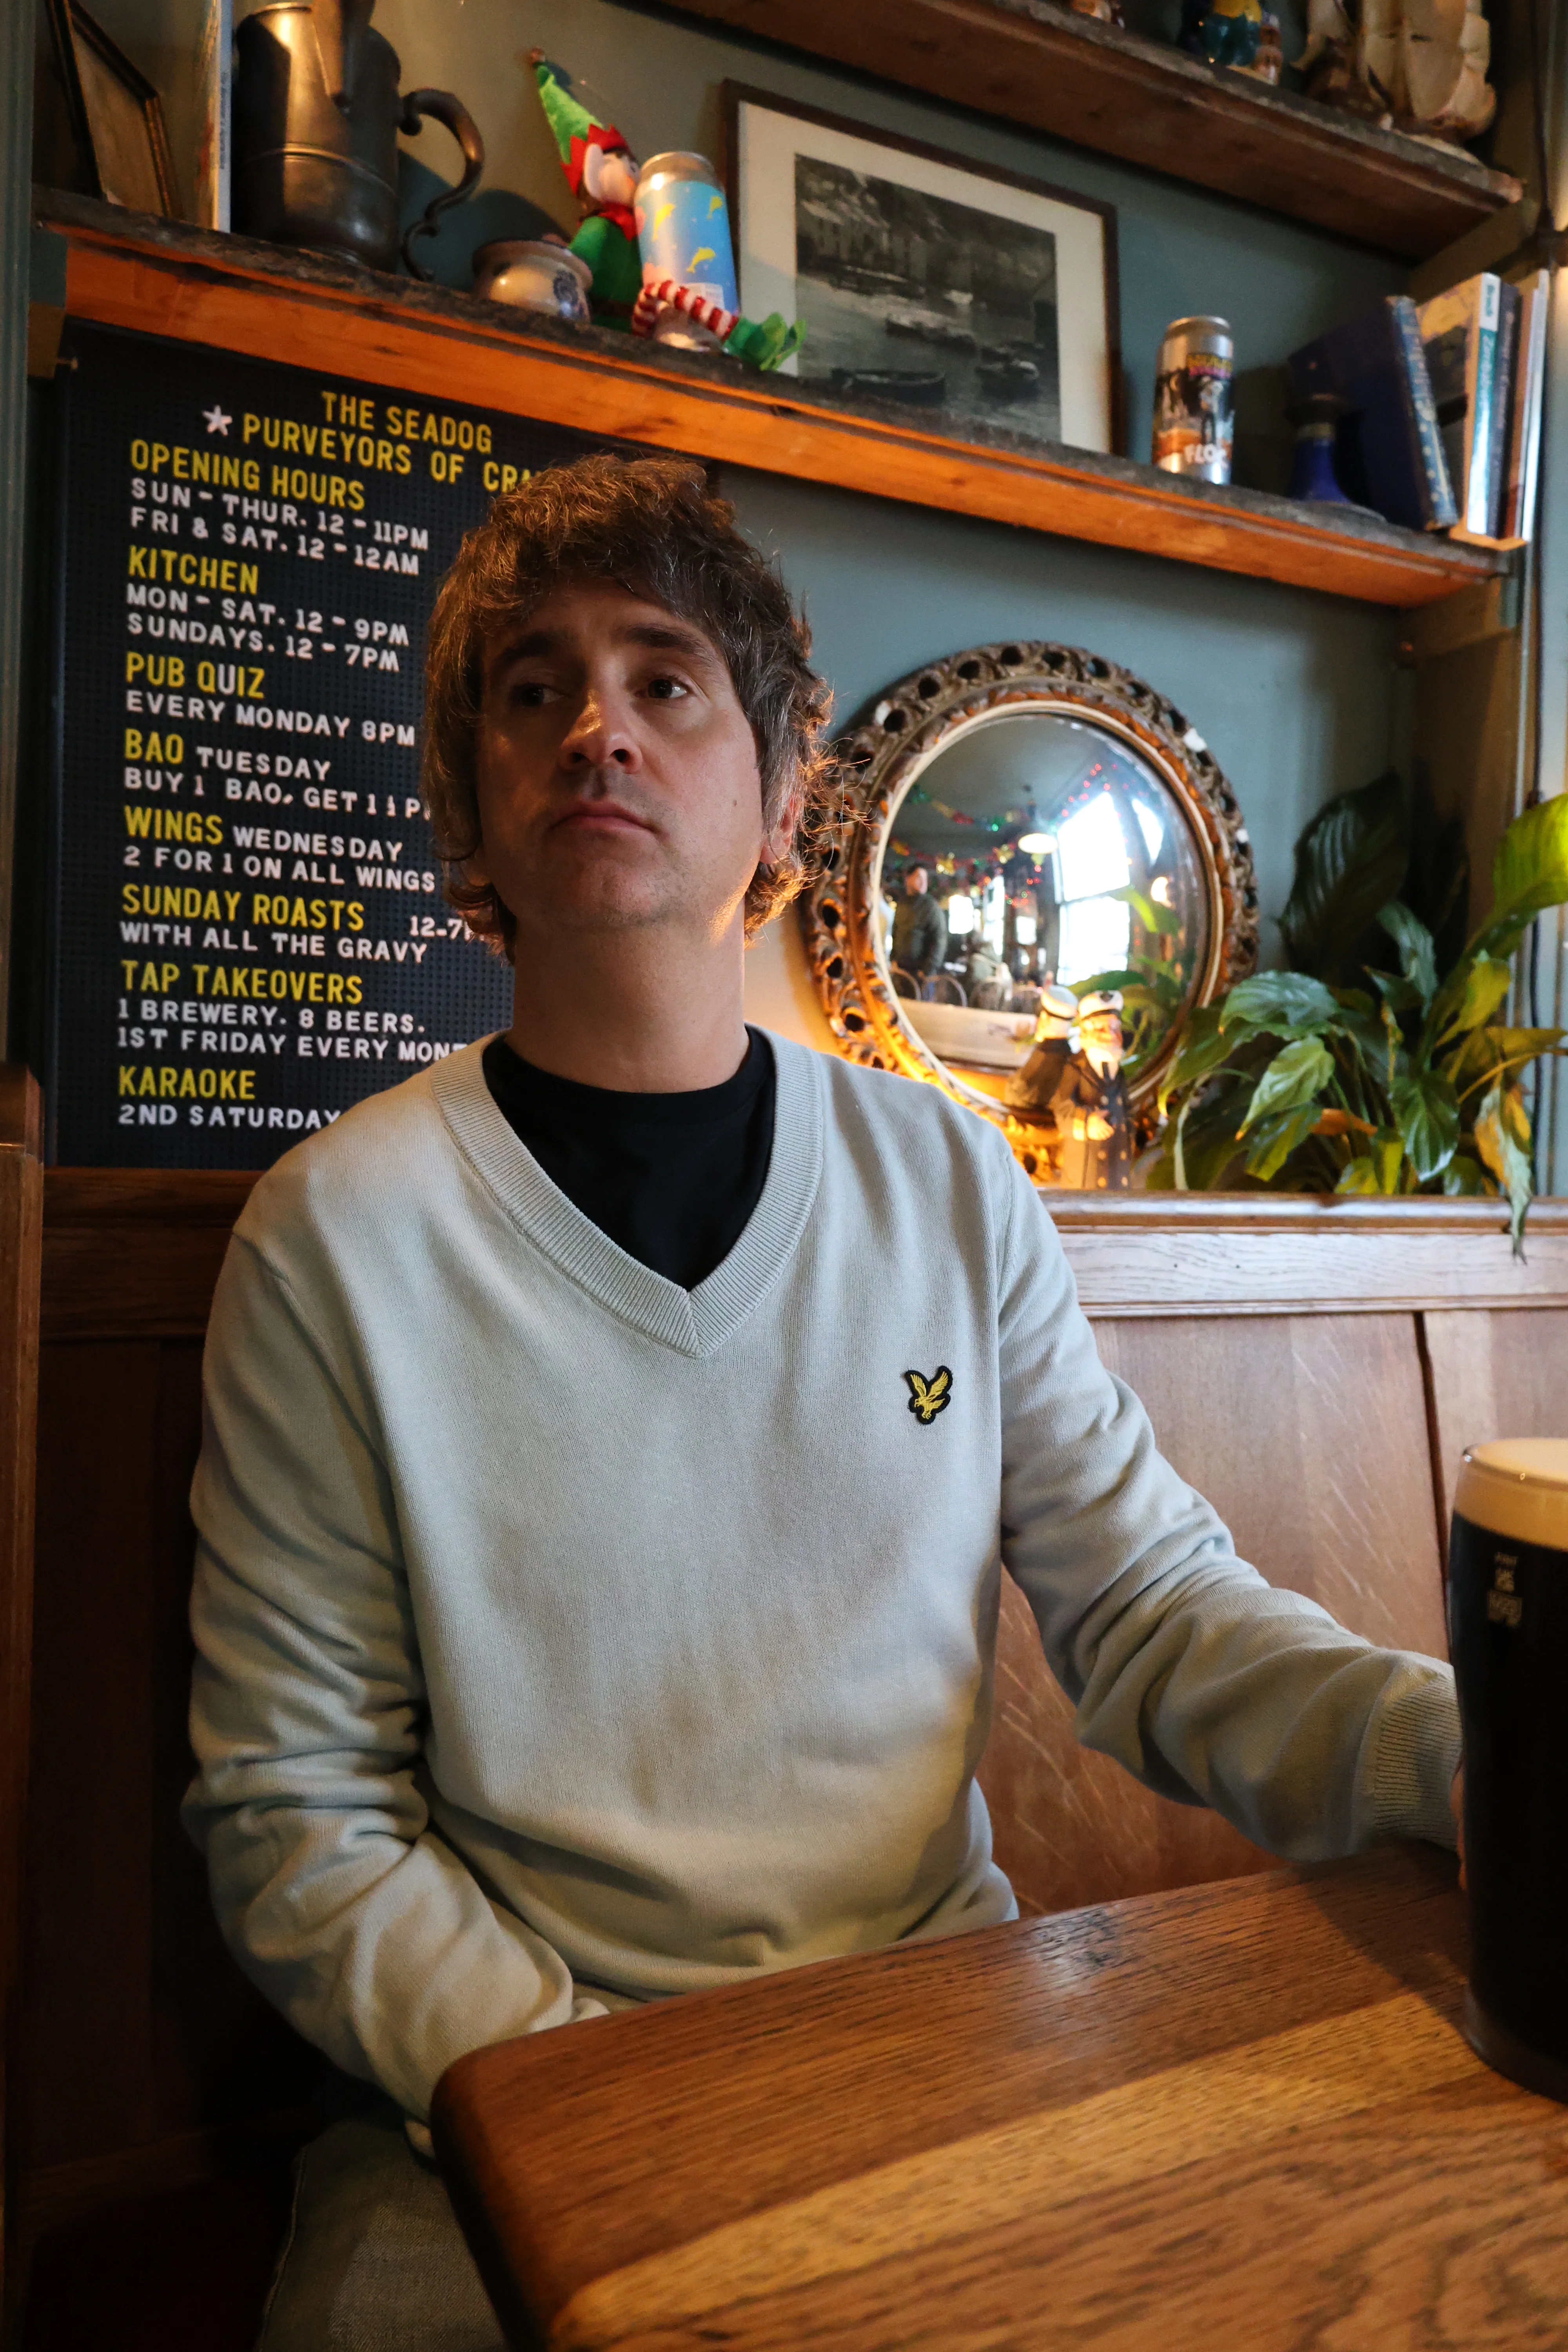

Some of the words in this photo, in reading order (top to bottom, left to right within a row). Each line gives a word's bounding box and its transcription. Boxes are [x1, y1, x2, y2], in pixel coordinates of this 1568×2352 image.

[323, 392, 374, 430] THE
[387, 407, 491, 453] SEADOG
[244, 413, 411, 474] PURVEYORS
[431, 451, 464, 483] OF
[131, 439, 260, 491] OPENING
[272, 465, 364, 510] HOURS
[132, 506, 178, 534] FRI
[193, 518, 208, 538] &
[298, 535, 324, 559] 12
[354, 545, 418, 575] 12AM
[318, 512, 343, 534] 12
[374, 521, 428, 550] 11PM
[129, 546, 258, 594] KITCHEN
[128, 613, 275, 652] SUNDAYS.
[286, 636, 312, 659] 12
[345, 644, 399, 672] 7PM
[296, 609, 323, 633] 12
[355, 619, 408, 646] 9PM
[127, 652, 185, 687] PUB
[198, 662, 264, 698] QUIZ
[127, 690, 225, 722] EVERY
[236, 704, 350, 737] MONDAY
[362, 720, 415, 746] 8PM
[125, 729, 183, 764] BAO
[197, 747, 330, 780] TUESDAY
[125, 768, 183, 792] BUY
[195, 776, 204, 795] 1
[226, 779, 293, 804] BAO,
[304, 787, 358, 812] GET
[367, 794, 376, 815] 1
[125, 806, 223, 844] WINGS
[234, 826, 403, 862] WEDNESDAY
[124, 846, 140, 866] 2
[155, 848, 212, 871] FOR
[223, 853, 232, 873] 1
[244, 856, 281, 879] ON
[292, 860, 345, 884] ALL
[356, 866, 435, 893] WINGS
[123, 884, 241, 921] SUNDAY
[254, 894, 364, 931] ROASTS
[121, 922, 191, 946] WITH
[203, 928, 258, 951] ALL
[272, 933, 325, 956] THE
[338, 938, 427, 963] GRAVY
[122, 960, 179, 992] TAP
[193, 965, 362, 1004] TAKEOVERS
[120, 999, 128, 1018] 1
[142, 1000, 286, 1026] BREWERY.
[299, 1009, 314, 1029] 8
[327, 1010, 425, 1034] BEERS.
[119, 1027, 167, 1048] 1ST
[182, 1030, 285, 1054] FRIDAY
[298, 1036, 388, 1060] EVERY
[398, 1040, 466, 1062] MON
[120, 1066, 255, 1099] KARAOKE
[119, 1105, 177, 1124] 2ND
